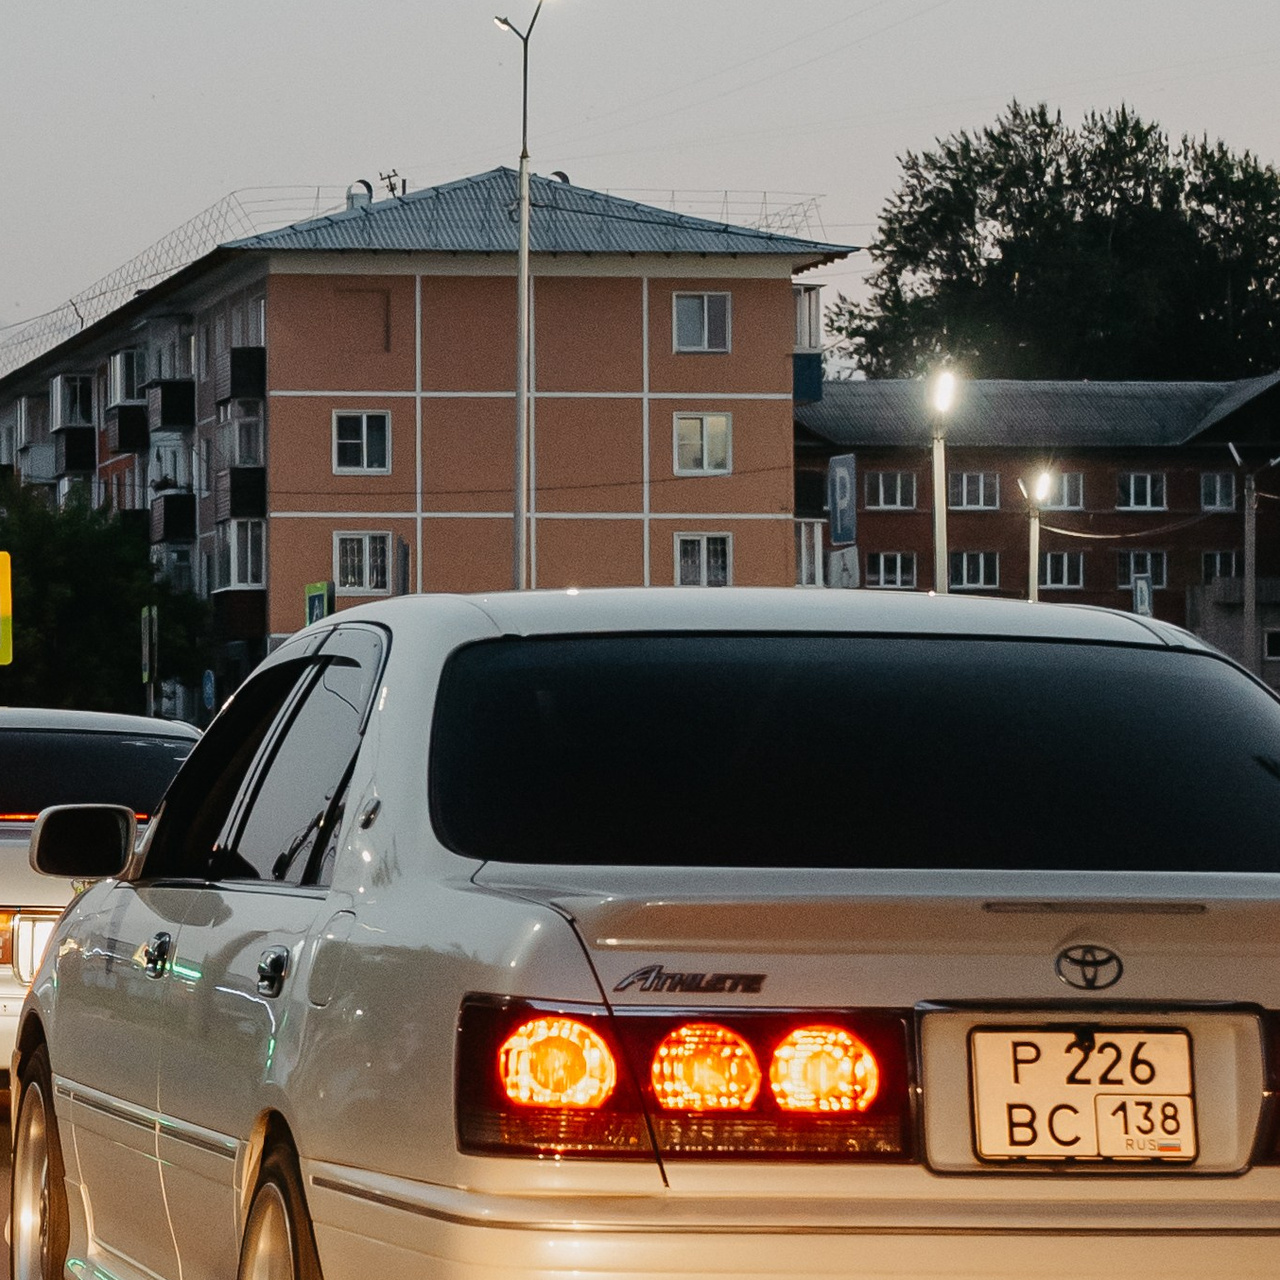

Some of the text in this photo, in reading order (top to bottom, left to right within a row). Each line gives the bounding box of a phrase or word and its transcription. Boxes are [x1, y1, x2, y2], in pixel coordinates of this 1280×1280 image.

[835, 466, 850, 534] P
[1011, 1041, 1156, 1085] P 226
[1006, 1101, 1181, 1147] BC 138
[1126, 1138, 1157, 1151] RUS
